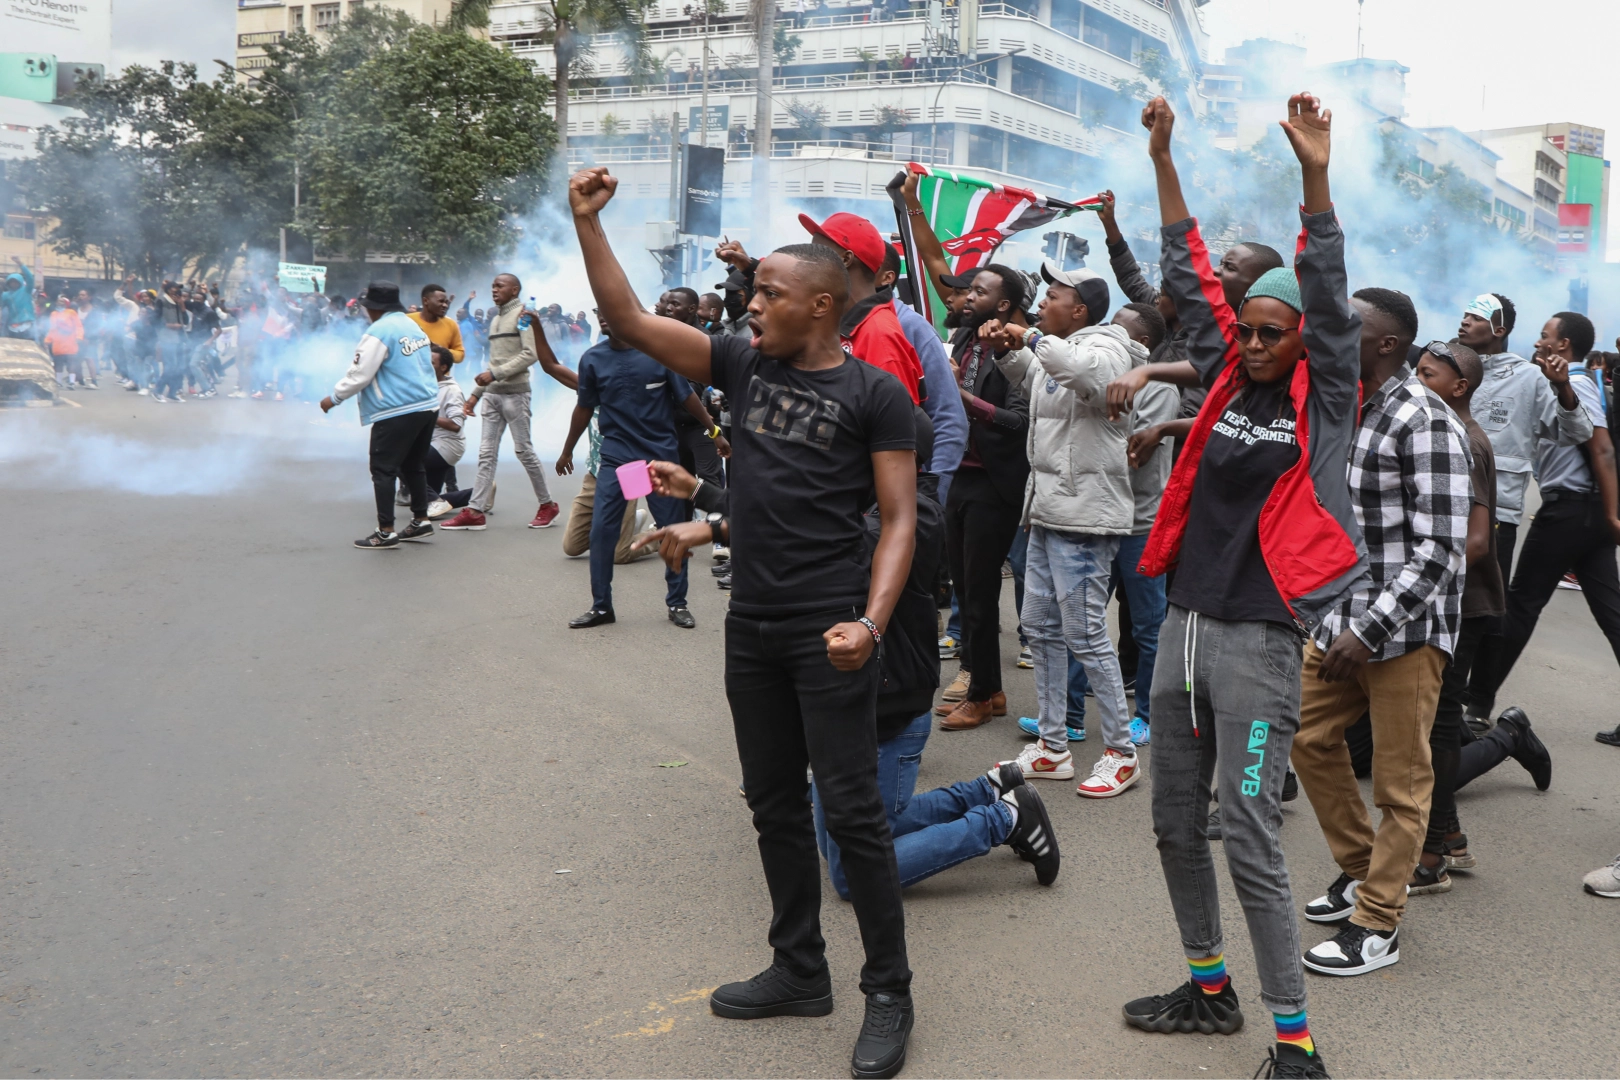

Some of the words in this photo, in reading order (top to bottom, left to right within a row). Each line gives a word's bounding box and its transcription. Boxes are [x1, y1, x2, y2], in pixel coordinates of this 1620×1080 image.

[25, 7, 51, 19] Portrait
[52, 13, 75, 24] Expert
[240, 32, 281, 46] SUMMIT
[688, 187, 719, 198] Samsonite
[744, 378, 838, 443] PEPE
